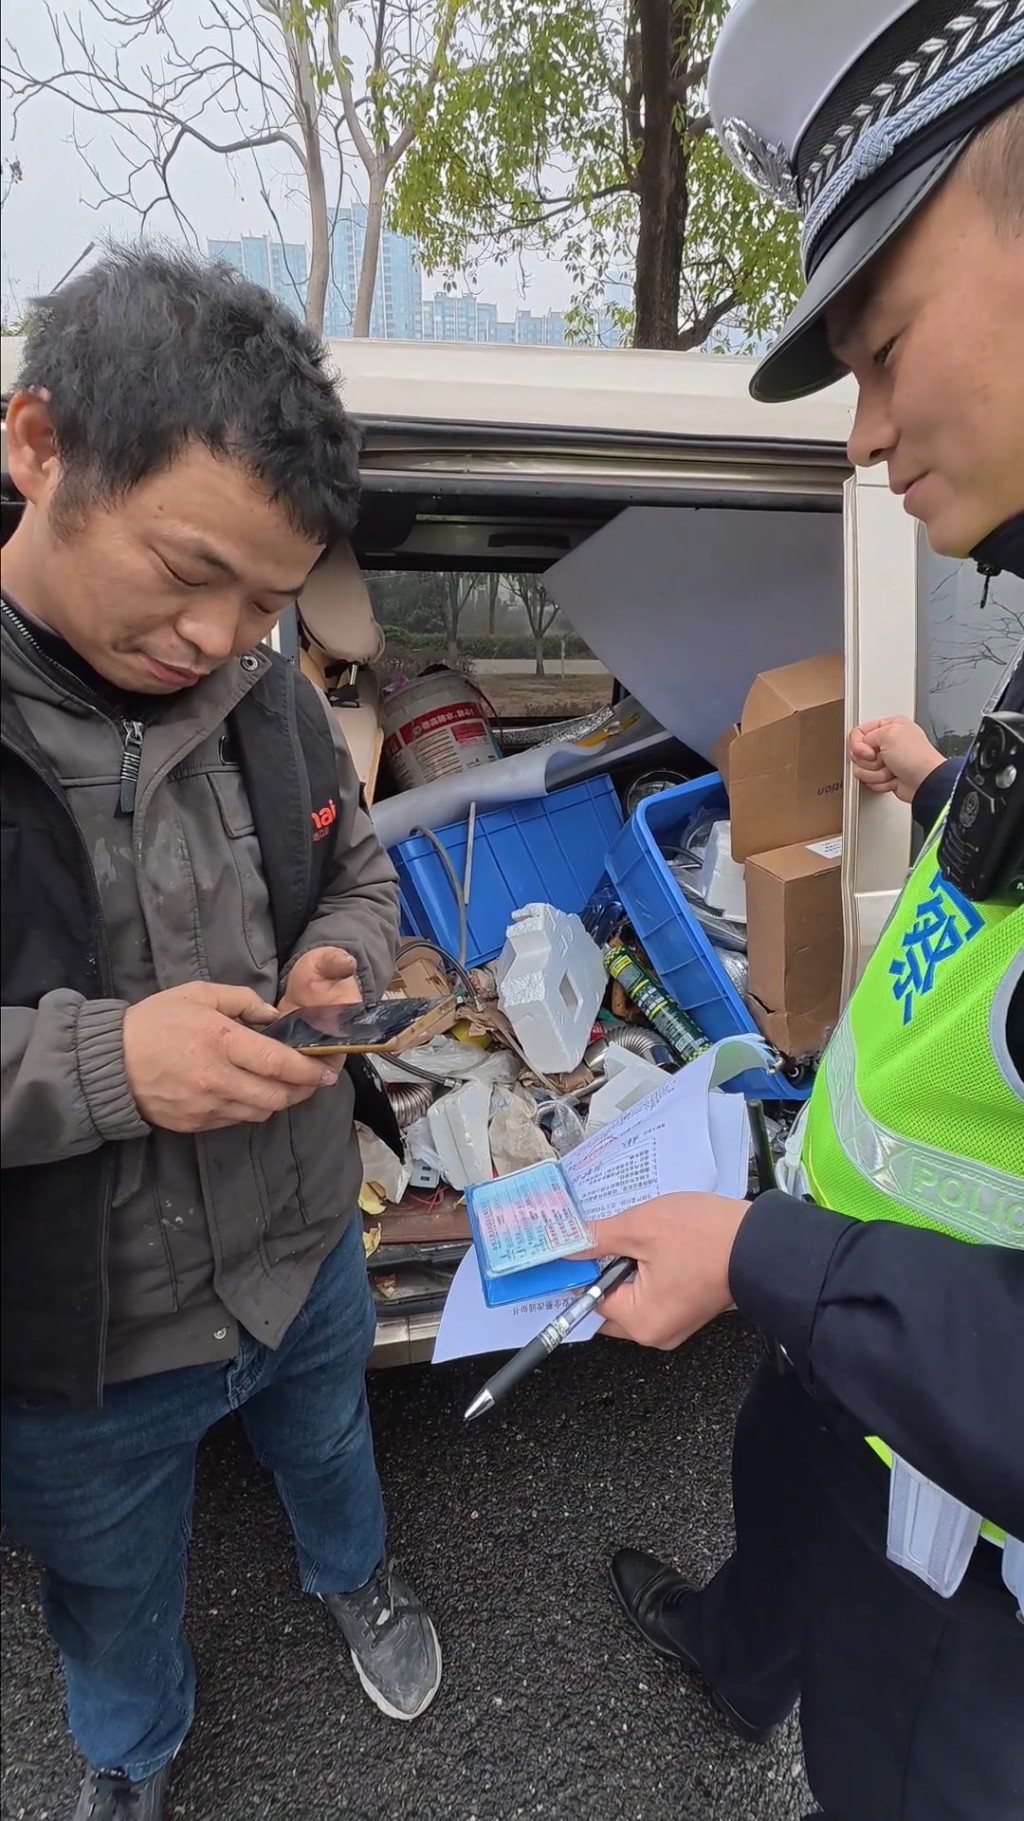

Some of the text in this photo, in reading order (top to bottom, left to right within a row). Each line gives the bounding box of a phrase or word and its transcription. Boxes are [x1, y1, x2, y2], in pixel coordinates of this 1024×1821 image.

[817, 780, 844, 796] tion
[513, 1297, 573, 1316] 安全整改通知书
